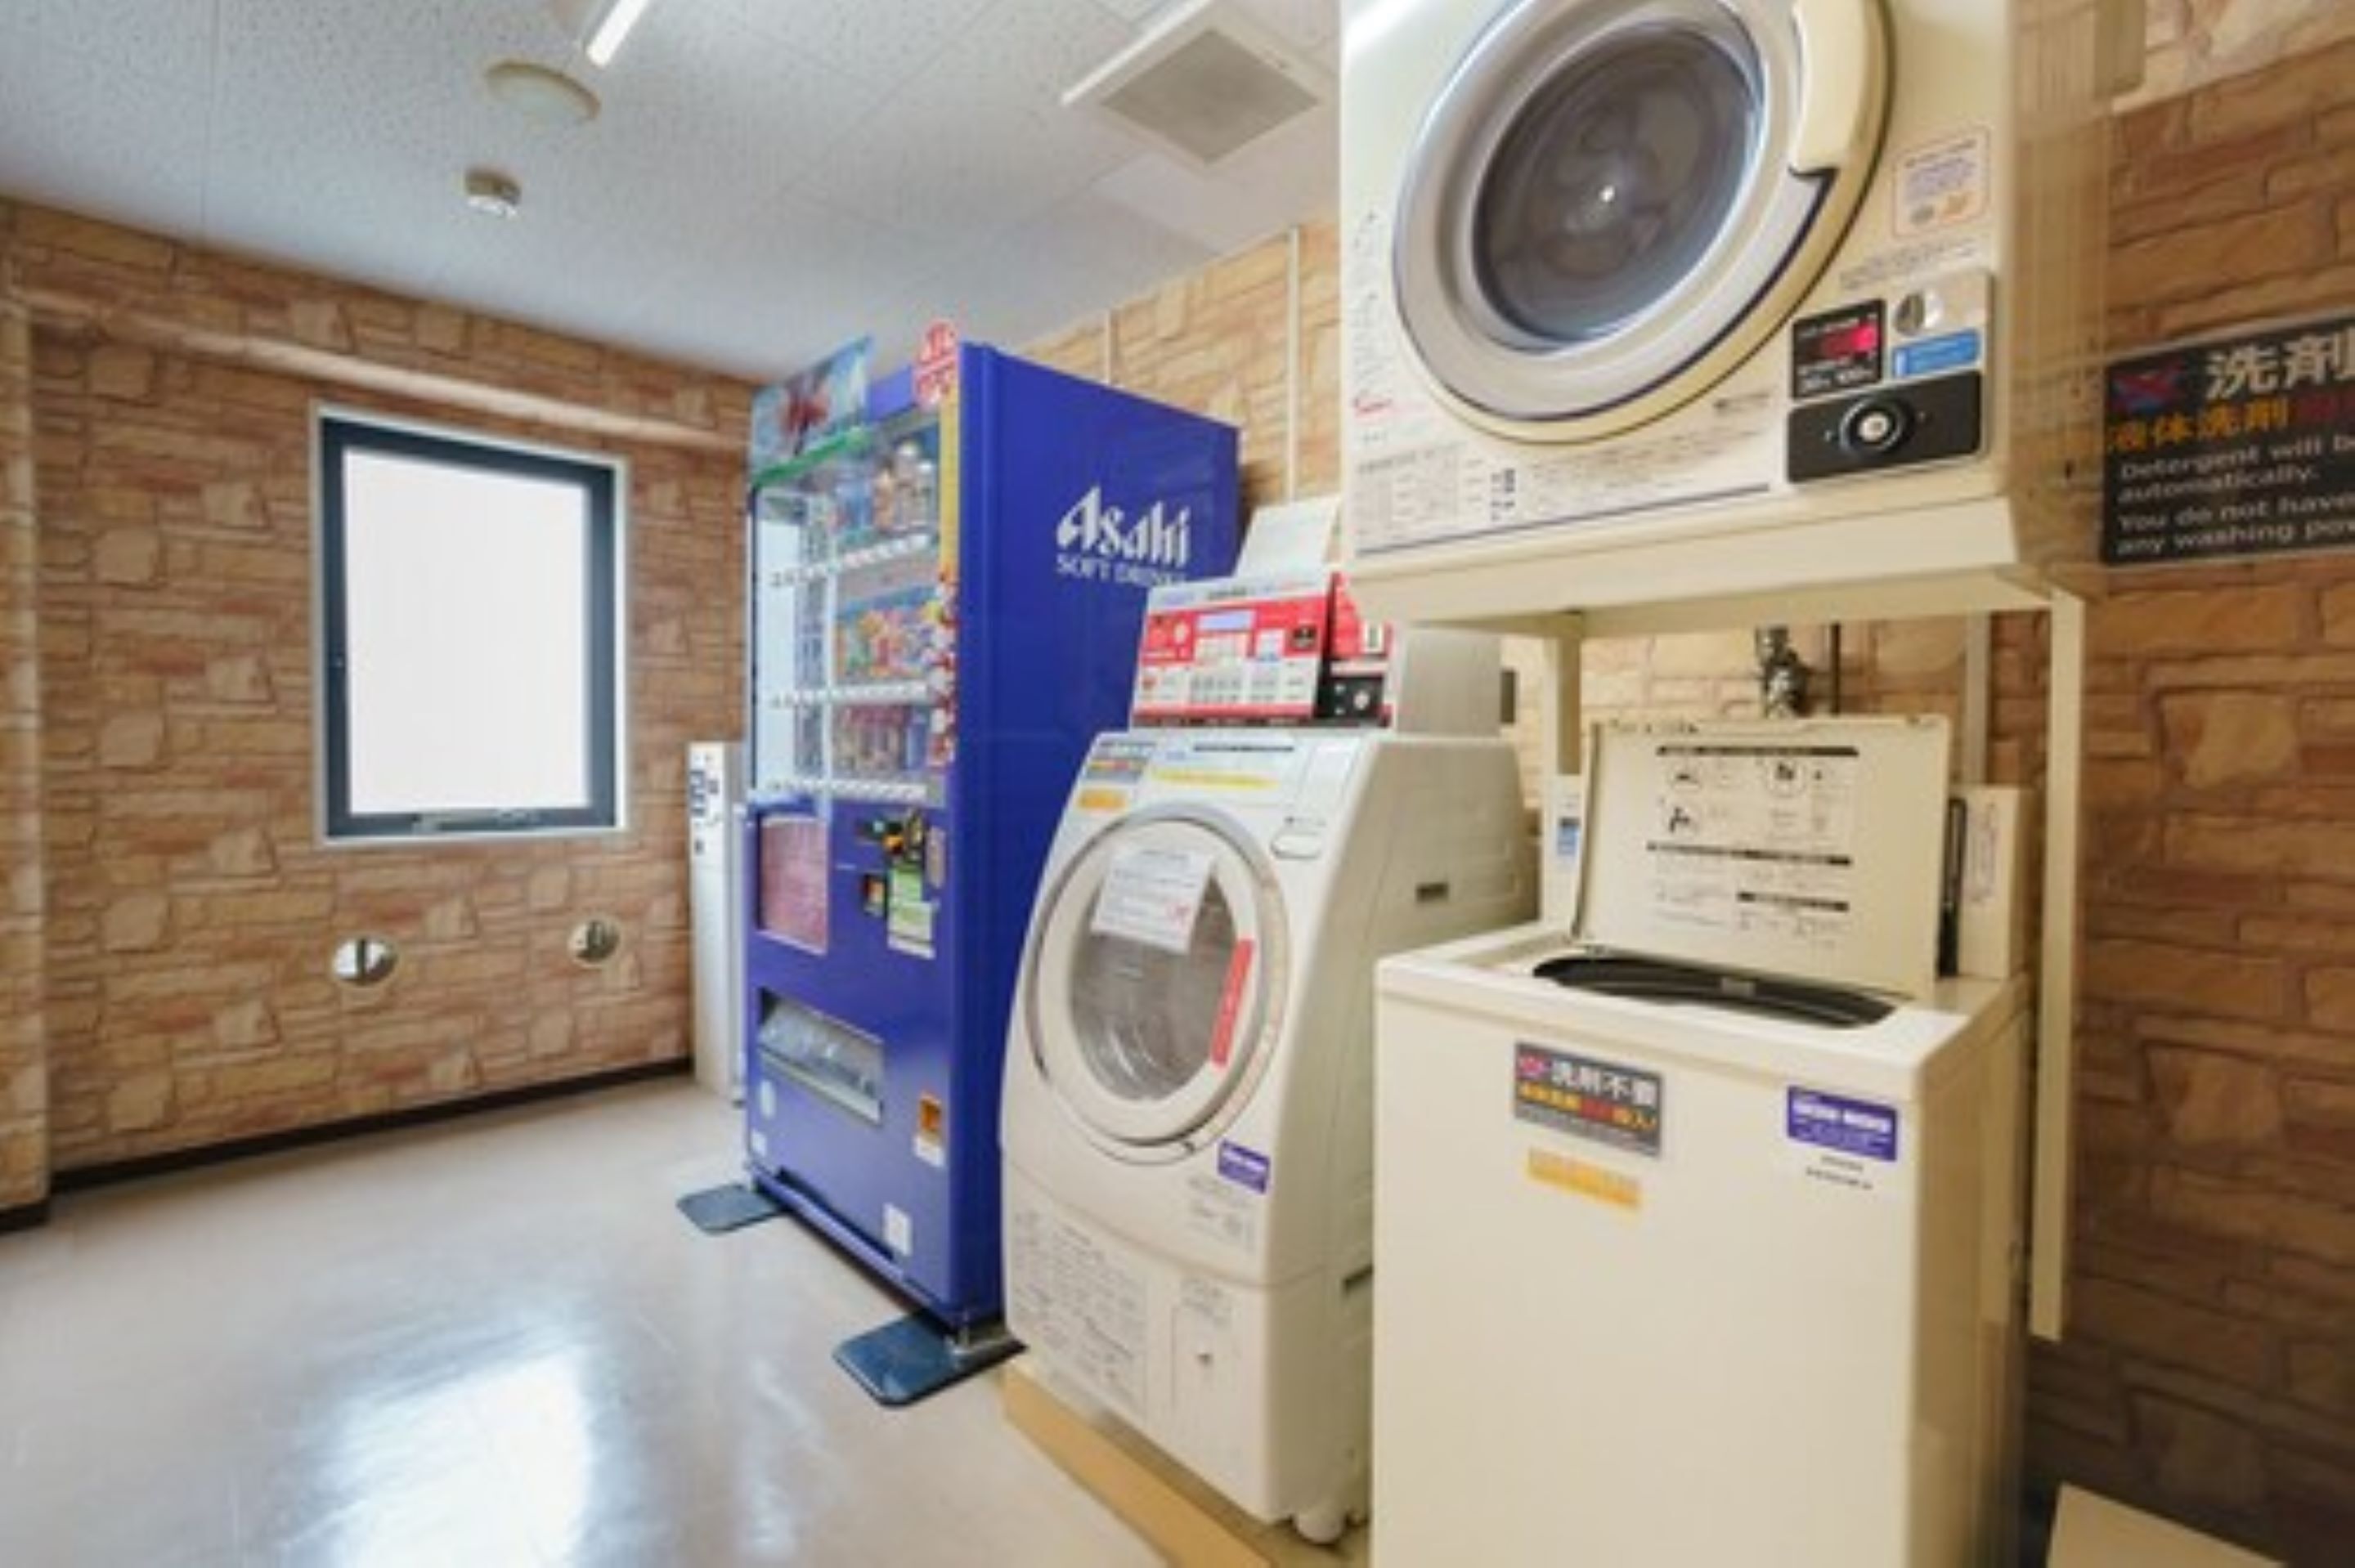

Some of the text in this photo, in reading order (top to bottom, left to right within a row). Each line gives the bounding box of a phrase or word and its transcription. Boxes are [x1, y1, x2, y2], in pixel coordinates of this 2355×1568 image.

[2121, 446, 2260, 481] Detergent
[2269, 436, 2323, 459] will
[1056, 485, 1191, 568] Asahi
[2219, 500, 2268, 520] not
[2118, 537, 2164, 556] any
[2173, 524, 2293, 548] washing
